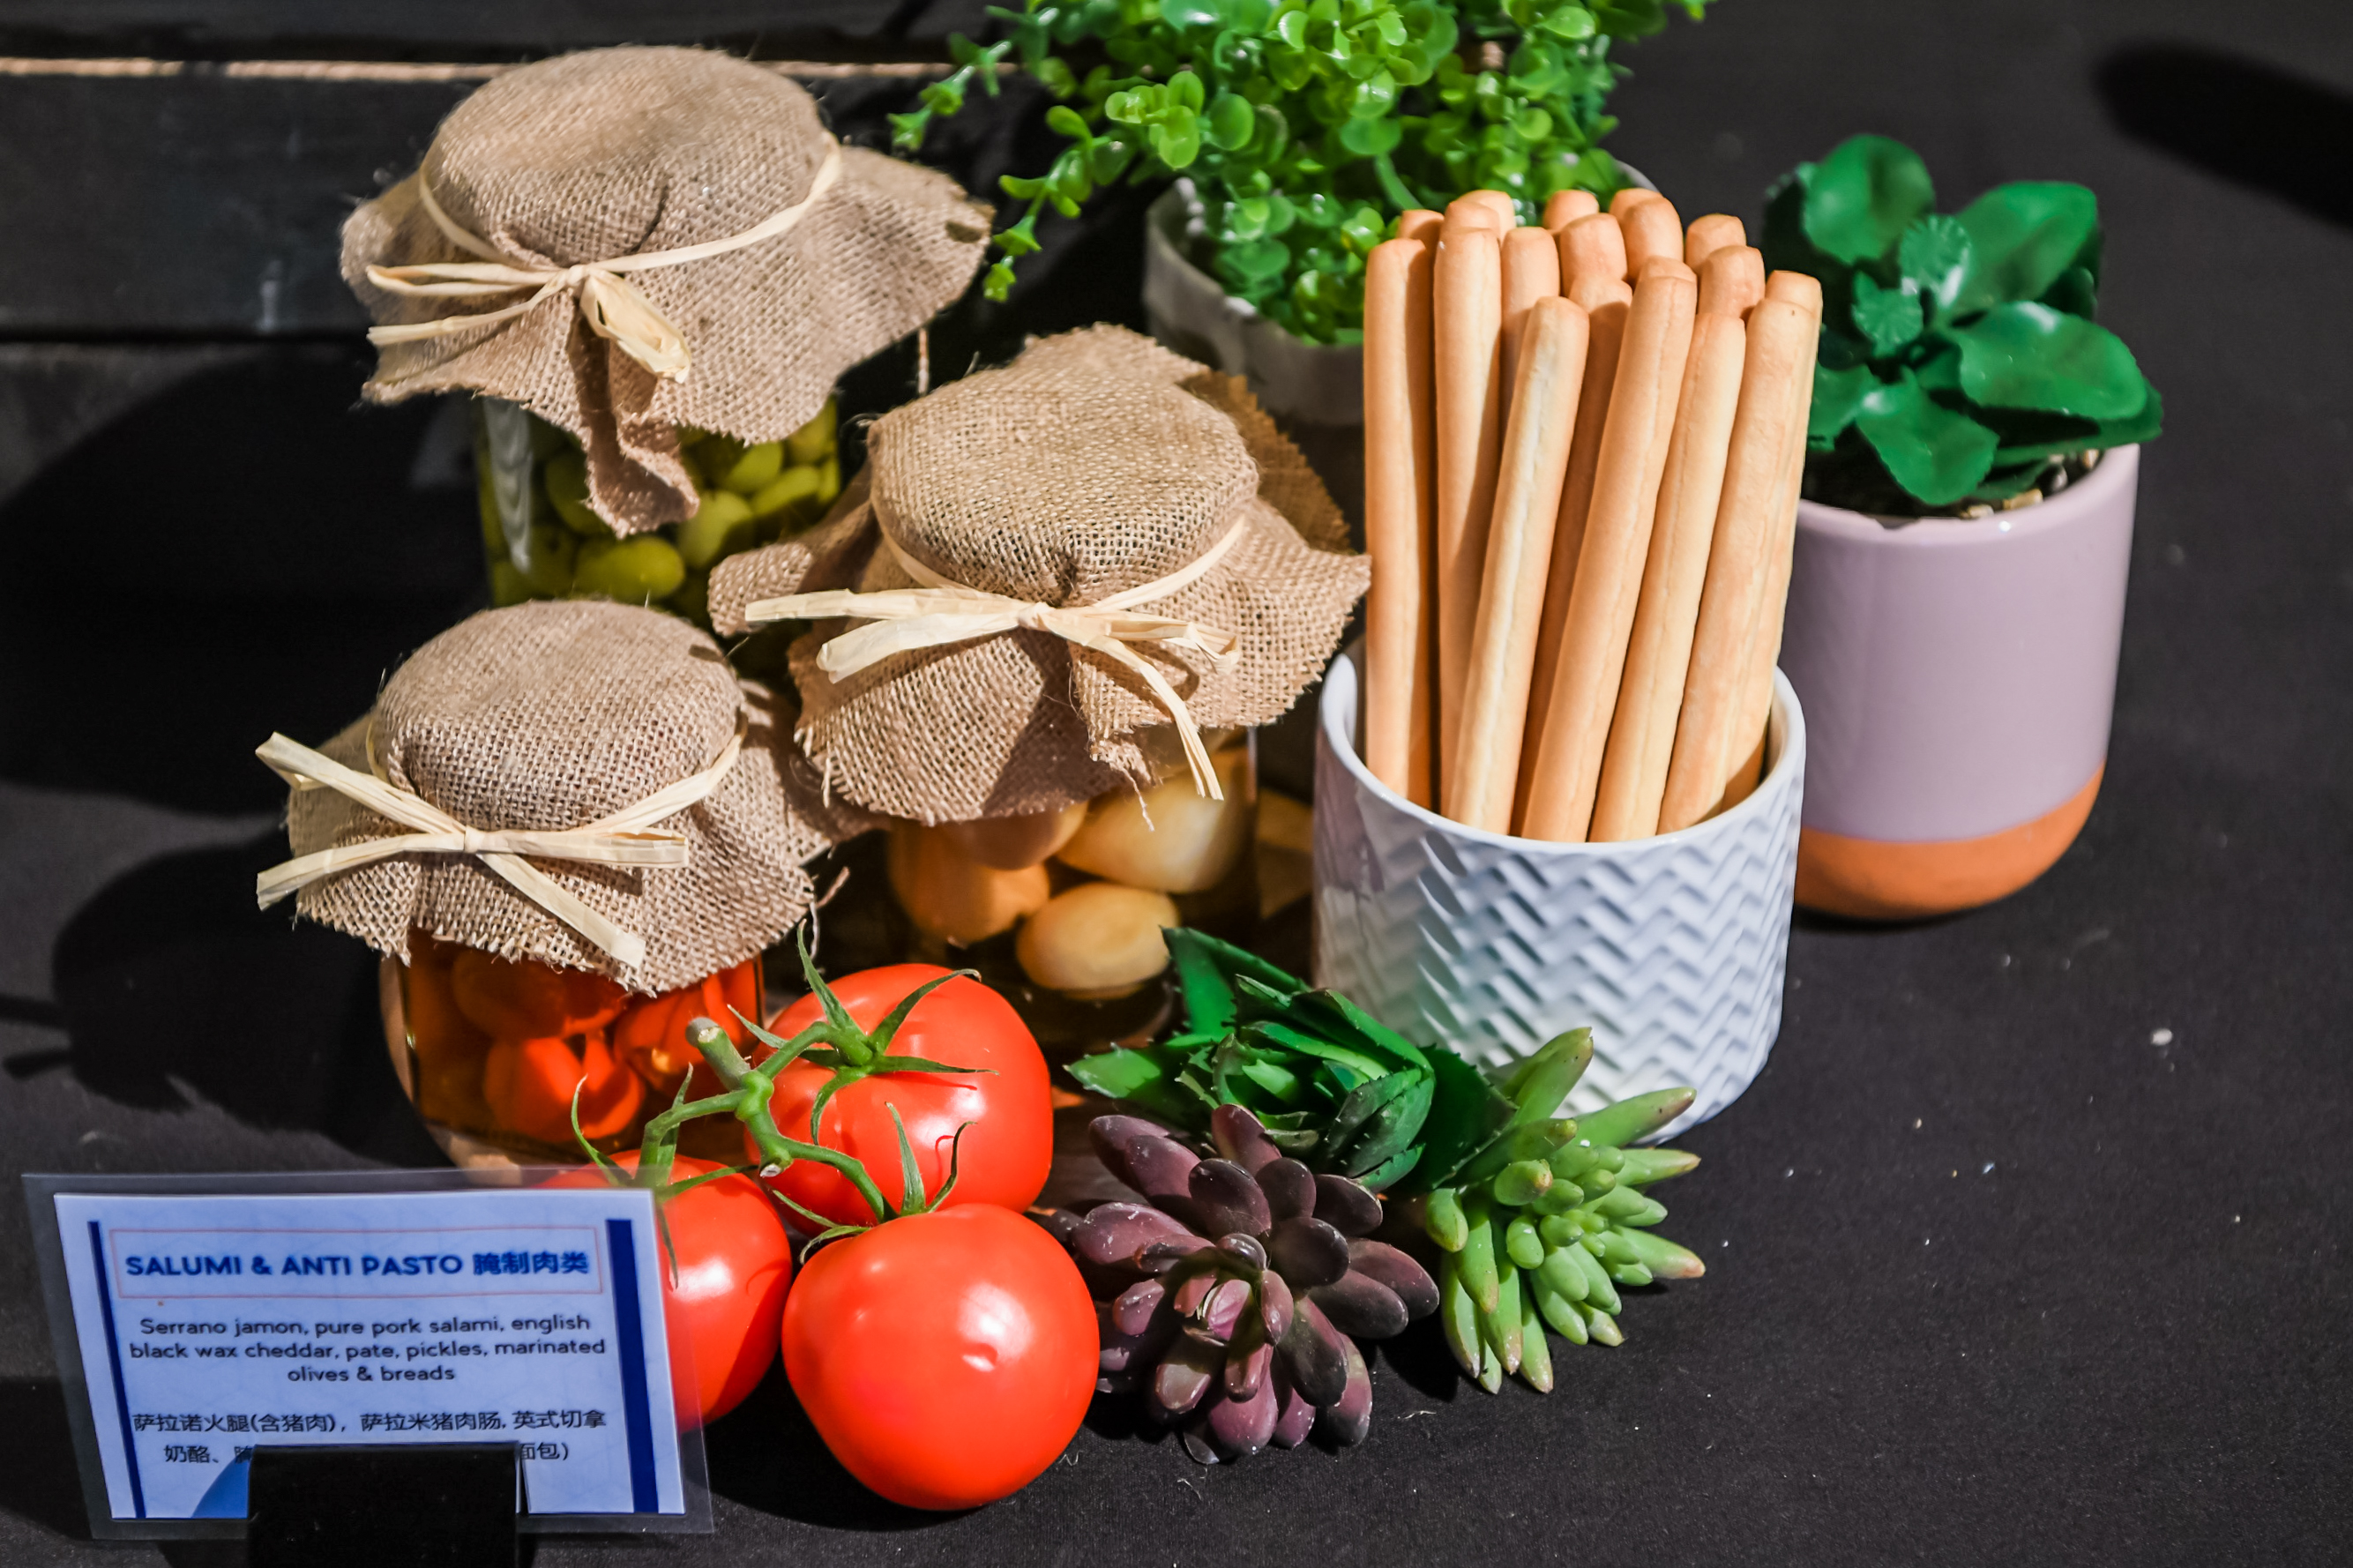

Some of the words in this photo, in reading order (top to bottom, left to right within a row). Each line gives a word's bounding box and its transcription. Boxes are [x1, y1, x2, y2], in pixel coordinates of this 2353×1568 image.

[125, 1256, 242, 1276] SALUMI
[250, 1255, 273, 1276] &
[281, 1255, 352, 1276] ANTI
[362, 1255, 463, 1276] PASTO
[472, 1251, 589, 1276] 腌制肉类
[140, 1318, 227, 1334] Serrano
[234, 1318, 309, 1338] jamon,
[315, 1323, 364, 1339] pure
[372, 1318, 422, 1339] pork
[430, 1317, 505, 1333] salami,
[511, 1314, 590, 1335] english
[130, 1342, 189, 1359] black
[195, 1347, 238, 1358] wax
[244, 1341, 340, 1360] cheddar,
[346, 1344, 400, 1362] pate,
[406, 1340, 488, 1362] pickles,
[494, 1339, 606, 1355] marinated
[288, 1365, 349, 1382] olives
[356, 1366, 374, 1382] &
[380, 1364, 455, 1381] breads
